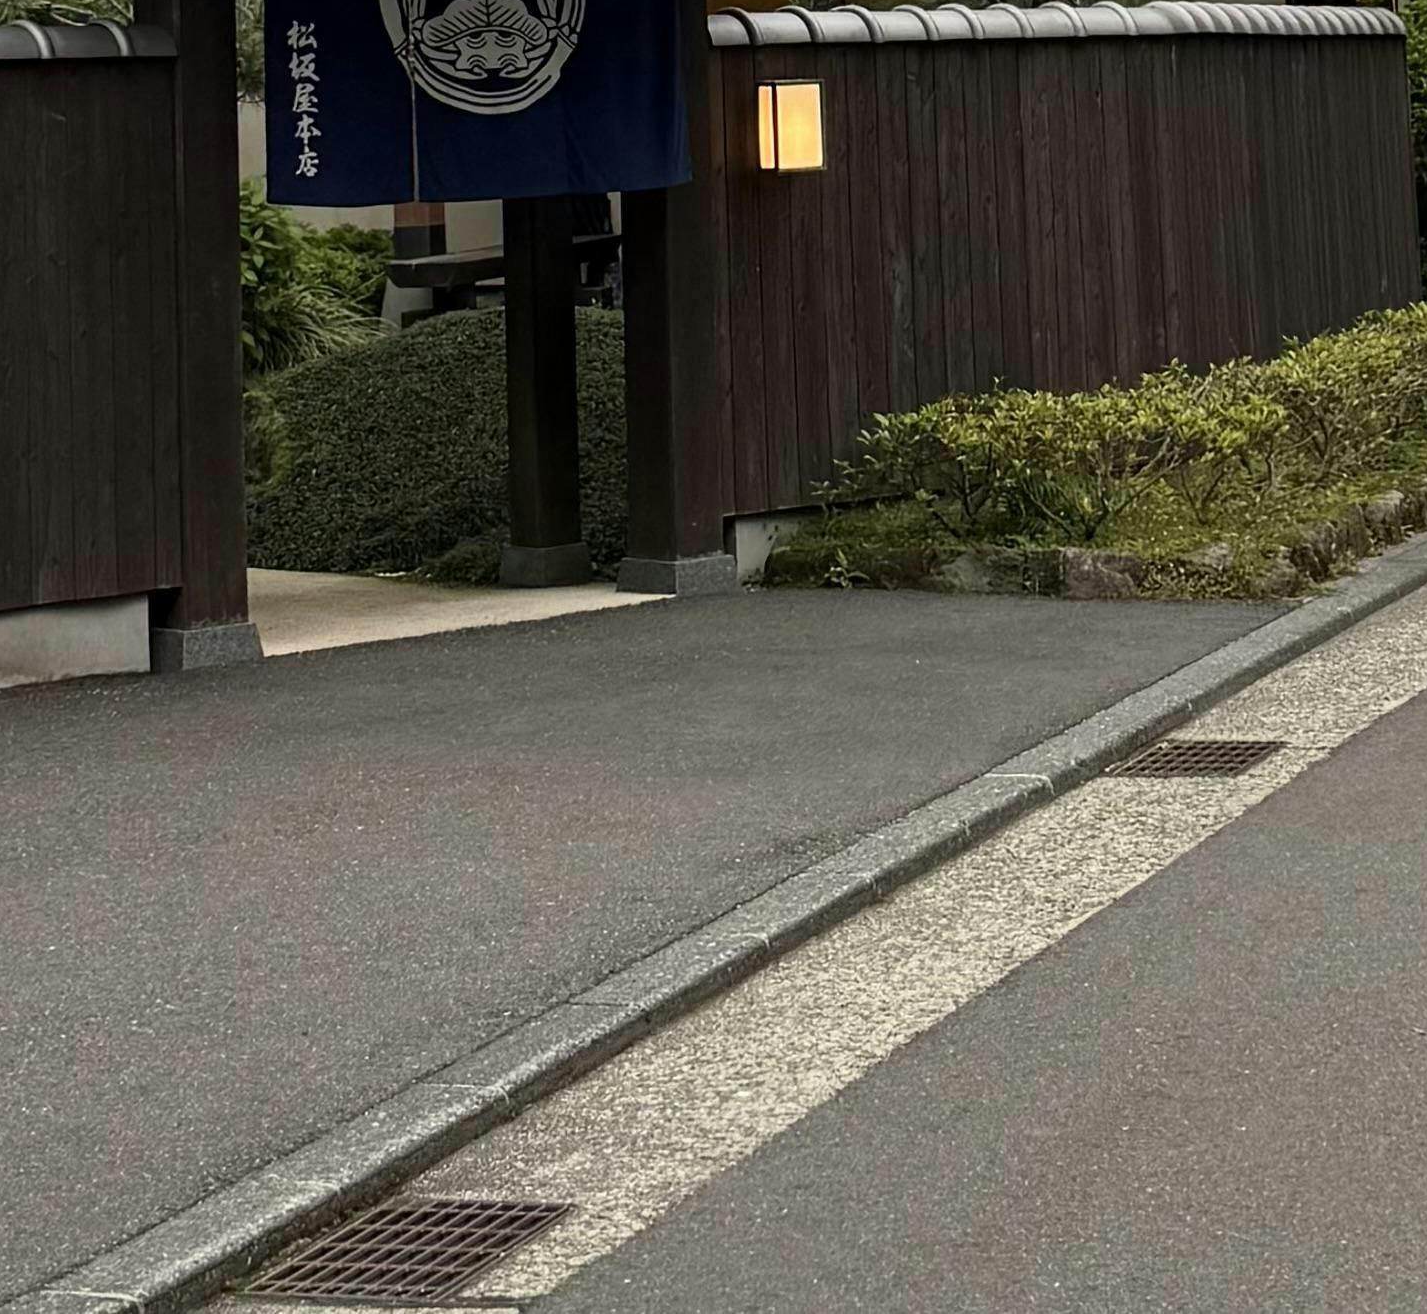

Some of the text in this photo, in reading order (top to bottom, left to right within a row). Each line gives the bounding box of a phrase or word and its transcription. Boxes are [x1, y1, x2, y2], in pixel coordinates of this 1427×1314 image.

[287, 20, 321, 177] 松坂屋本店
